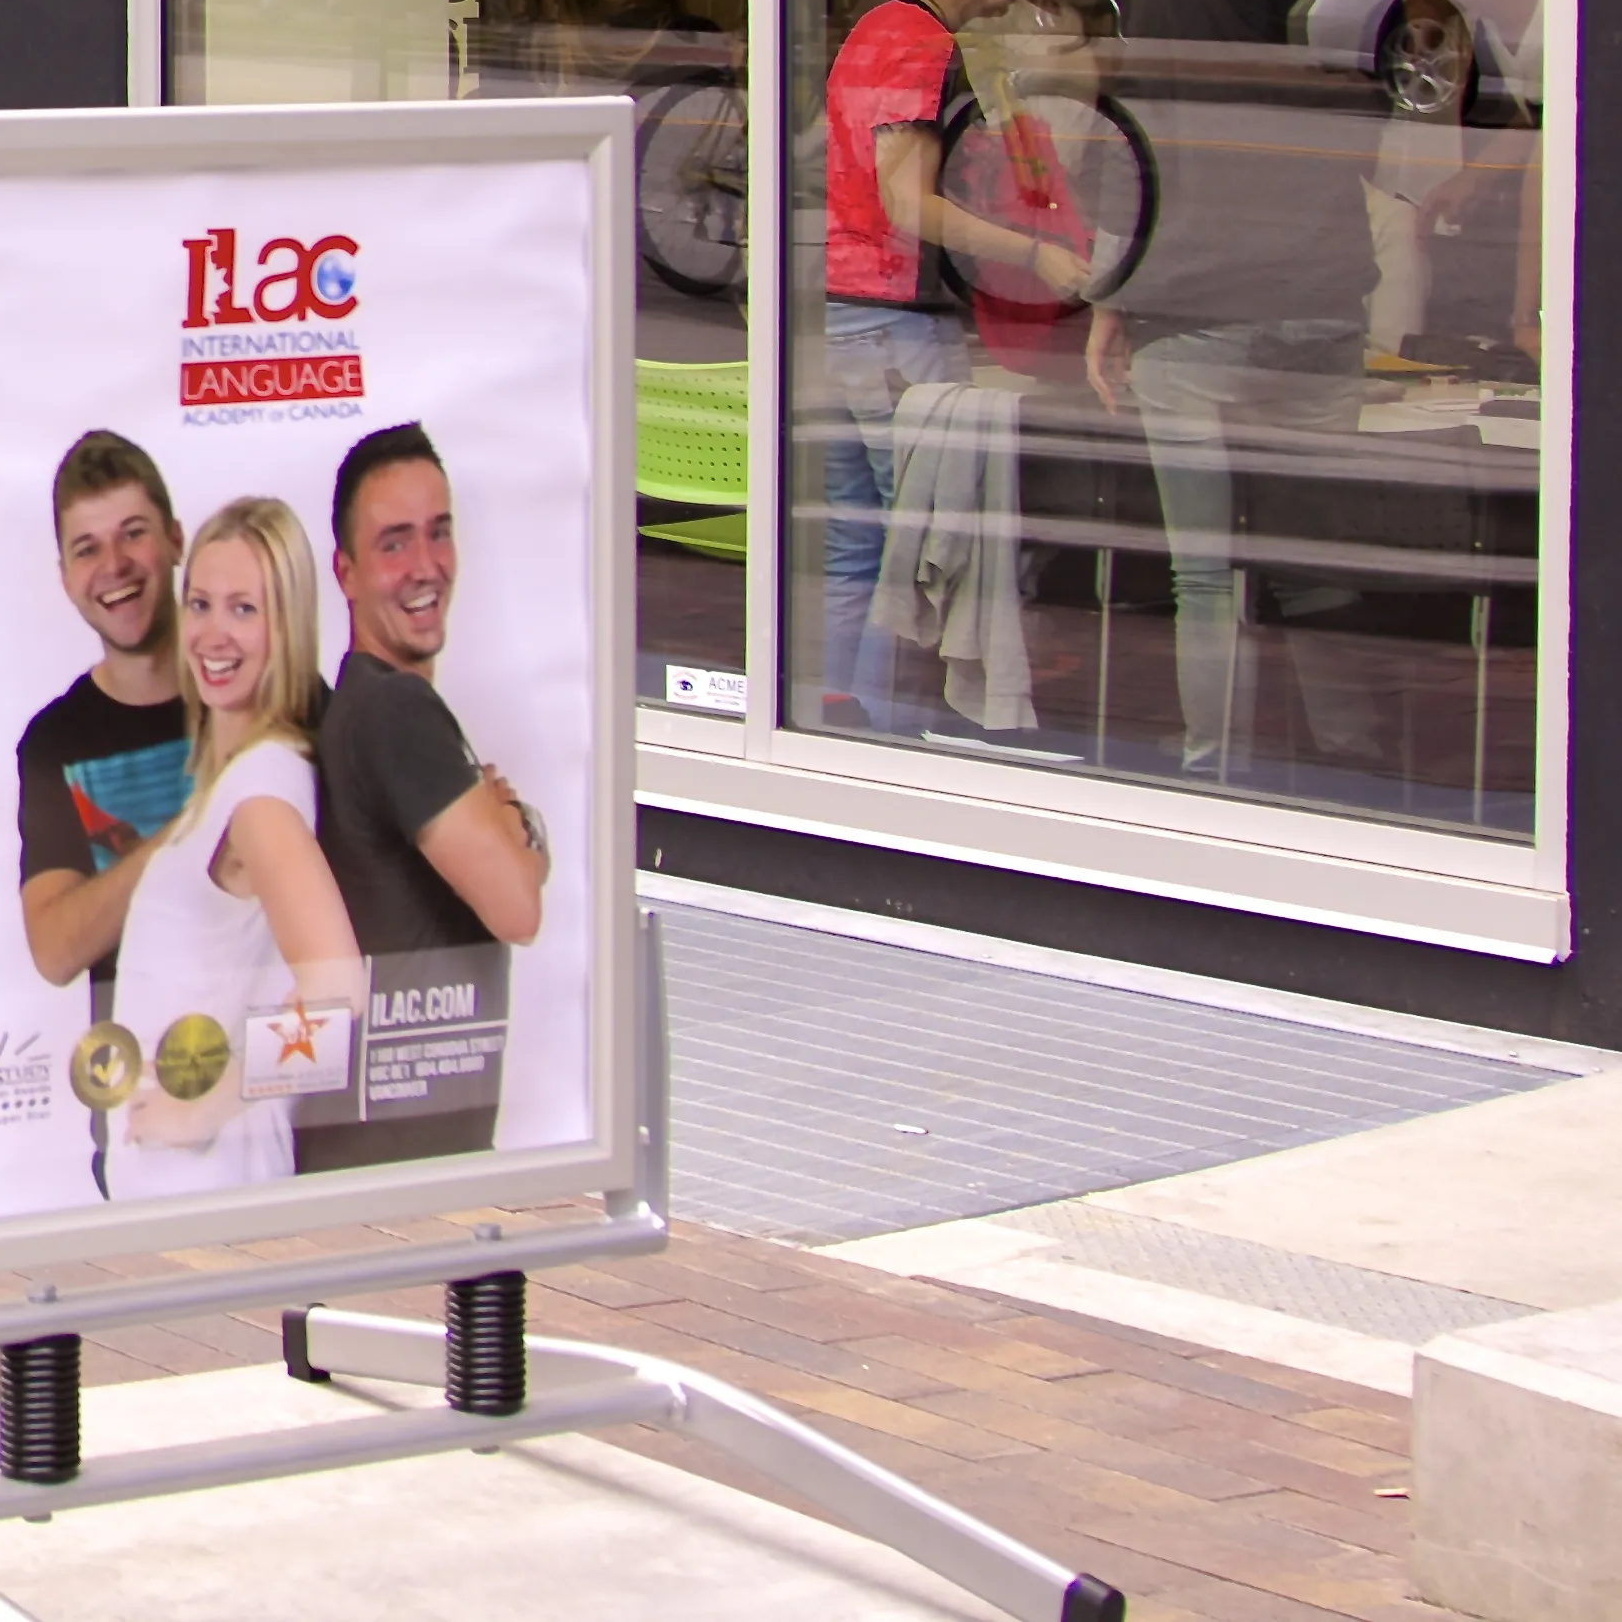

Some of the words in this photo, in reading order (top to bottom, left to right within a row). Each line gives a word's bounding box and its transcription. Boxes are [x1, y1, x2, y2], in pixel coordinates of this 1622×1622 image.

[180, 329, 361, 358] INTERNATIONAL
[183, 359, 363, 402] LANGUAGE
[182, 407, 265, 427] ACADEMY
[289, 401, 363, 421] CANADA
[709, 676, 745, 694] ACME
[371, 983, 475, 1027] ILAC.COM
